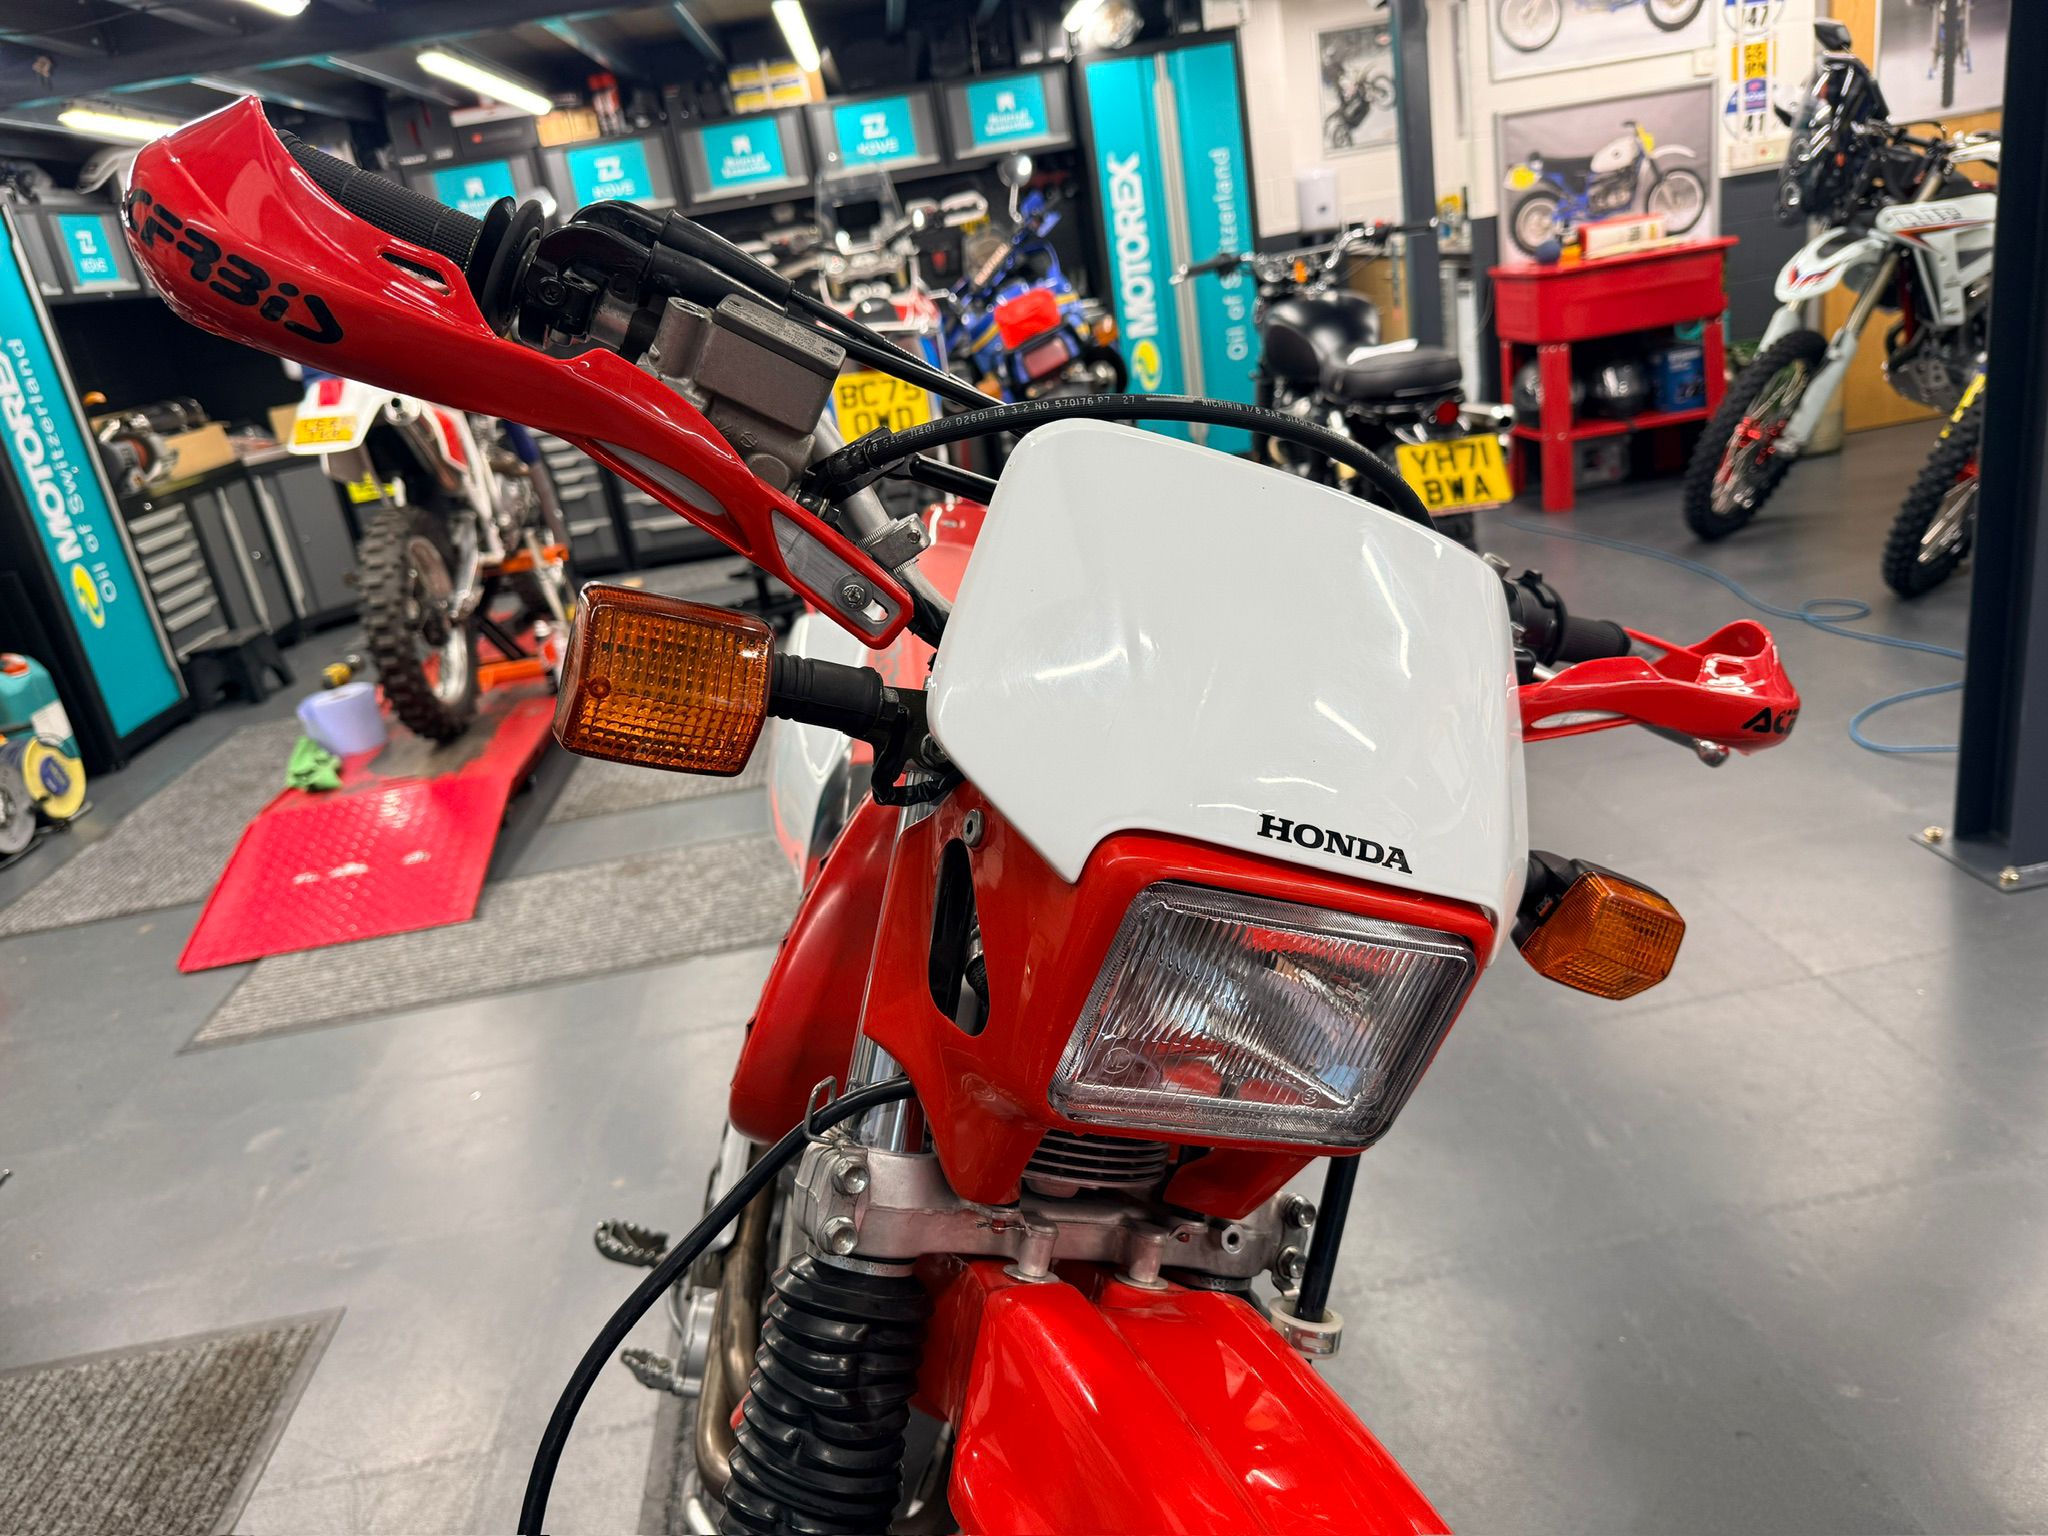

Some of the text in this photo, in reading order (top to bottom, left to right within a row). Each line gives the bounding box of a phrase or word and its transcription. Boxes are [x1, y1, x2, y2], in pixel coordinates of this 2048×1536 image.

[1106, 152, 1159, 340] MOTOREX
[1222, 295, 1245, 321] of
[1226, 325, 1249, 361] Oil
[1034, 401, 1050, 410] NO
[1054, 397, 1094, 409] 570176
[1122, 395, 1135, 405] 27
[0, 337, 84, 564] MOTORE
[7, 339, 118, 603] Oil of Switzerland
[1410, 441, 1490, 475] YH71
[1256, 813, 1413, 875] HONDA
